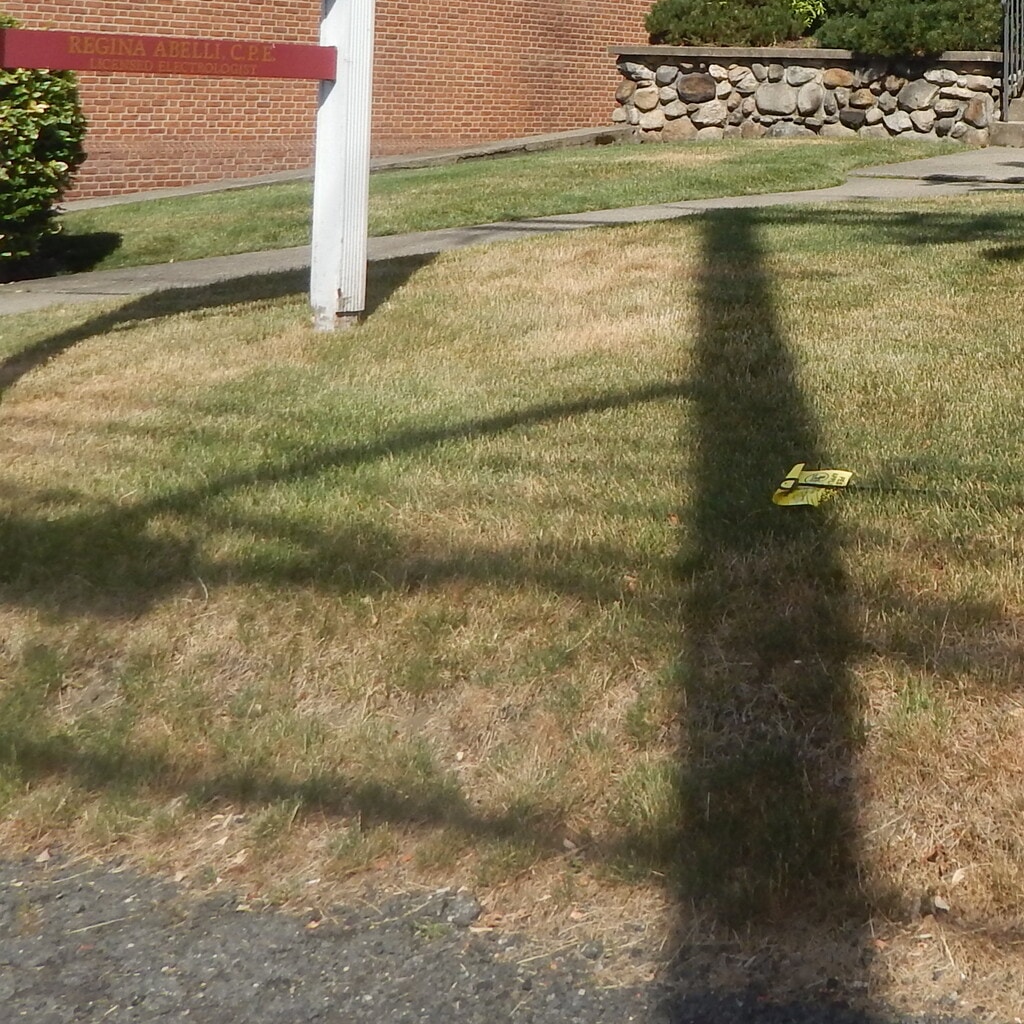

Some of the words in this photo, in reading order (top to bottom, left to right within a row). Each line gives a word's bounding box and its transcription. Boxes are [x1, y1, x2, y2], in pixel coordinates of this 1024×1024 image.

[68, 35, 146, 57] REGINA
[90, 57, 154, 72] LICENSED
[158, 61, 258, 75] ELECTROLOGIST
